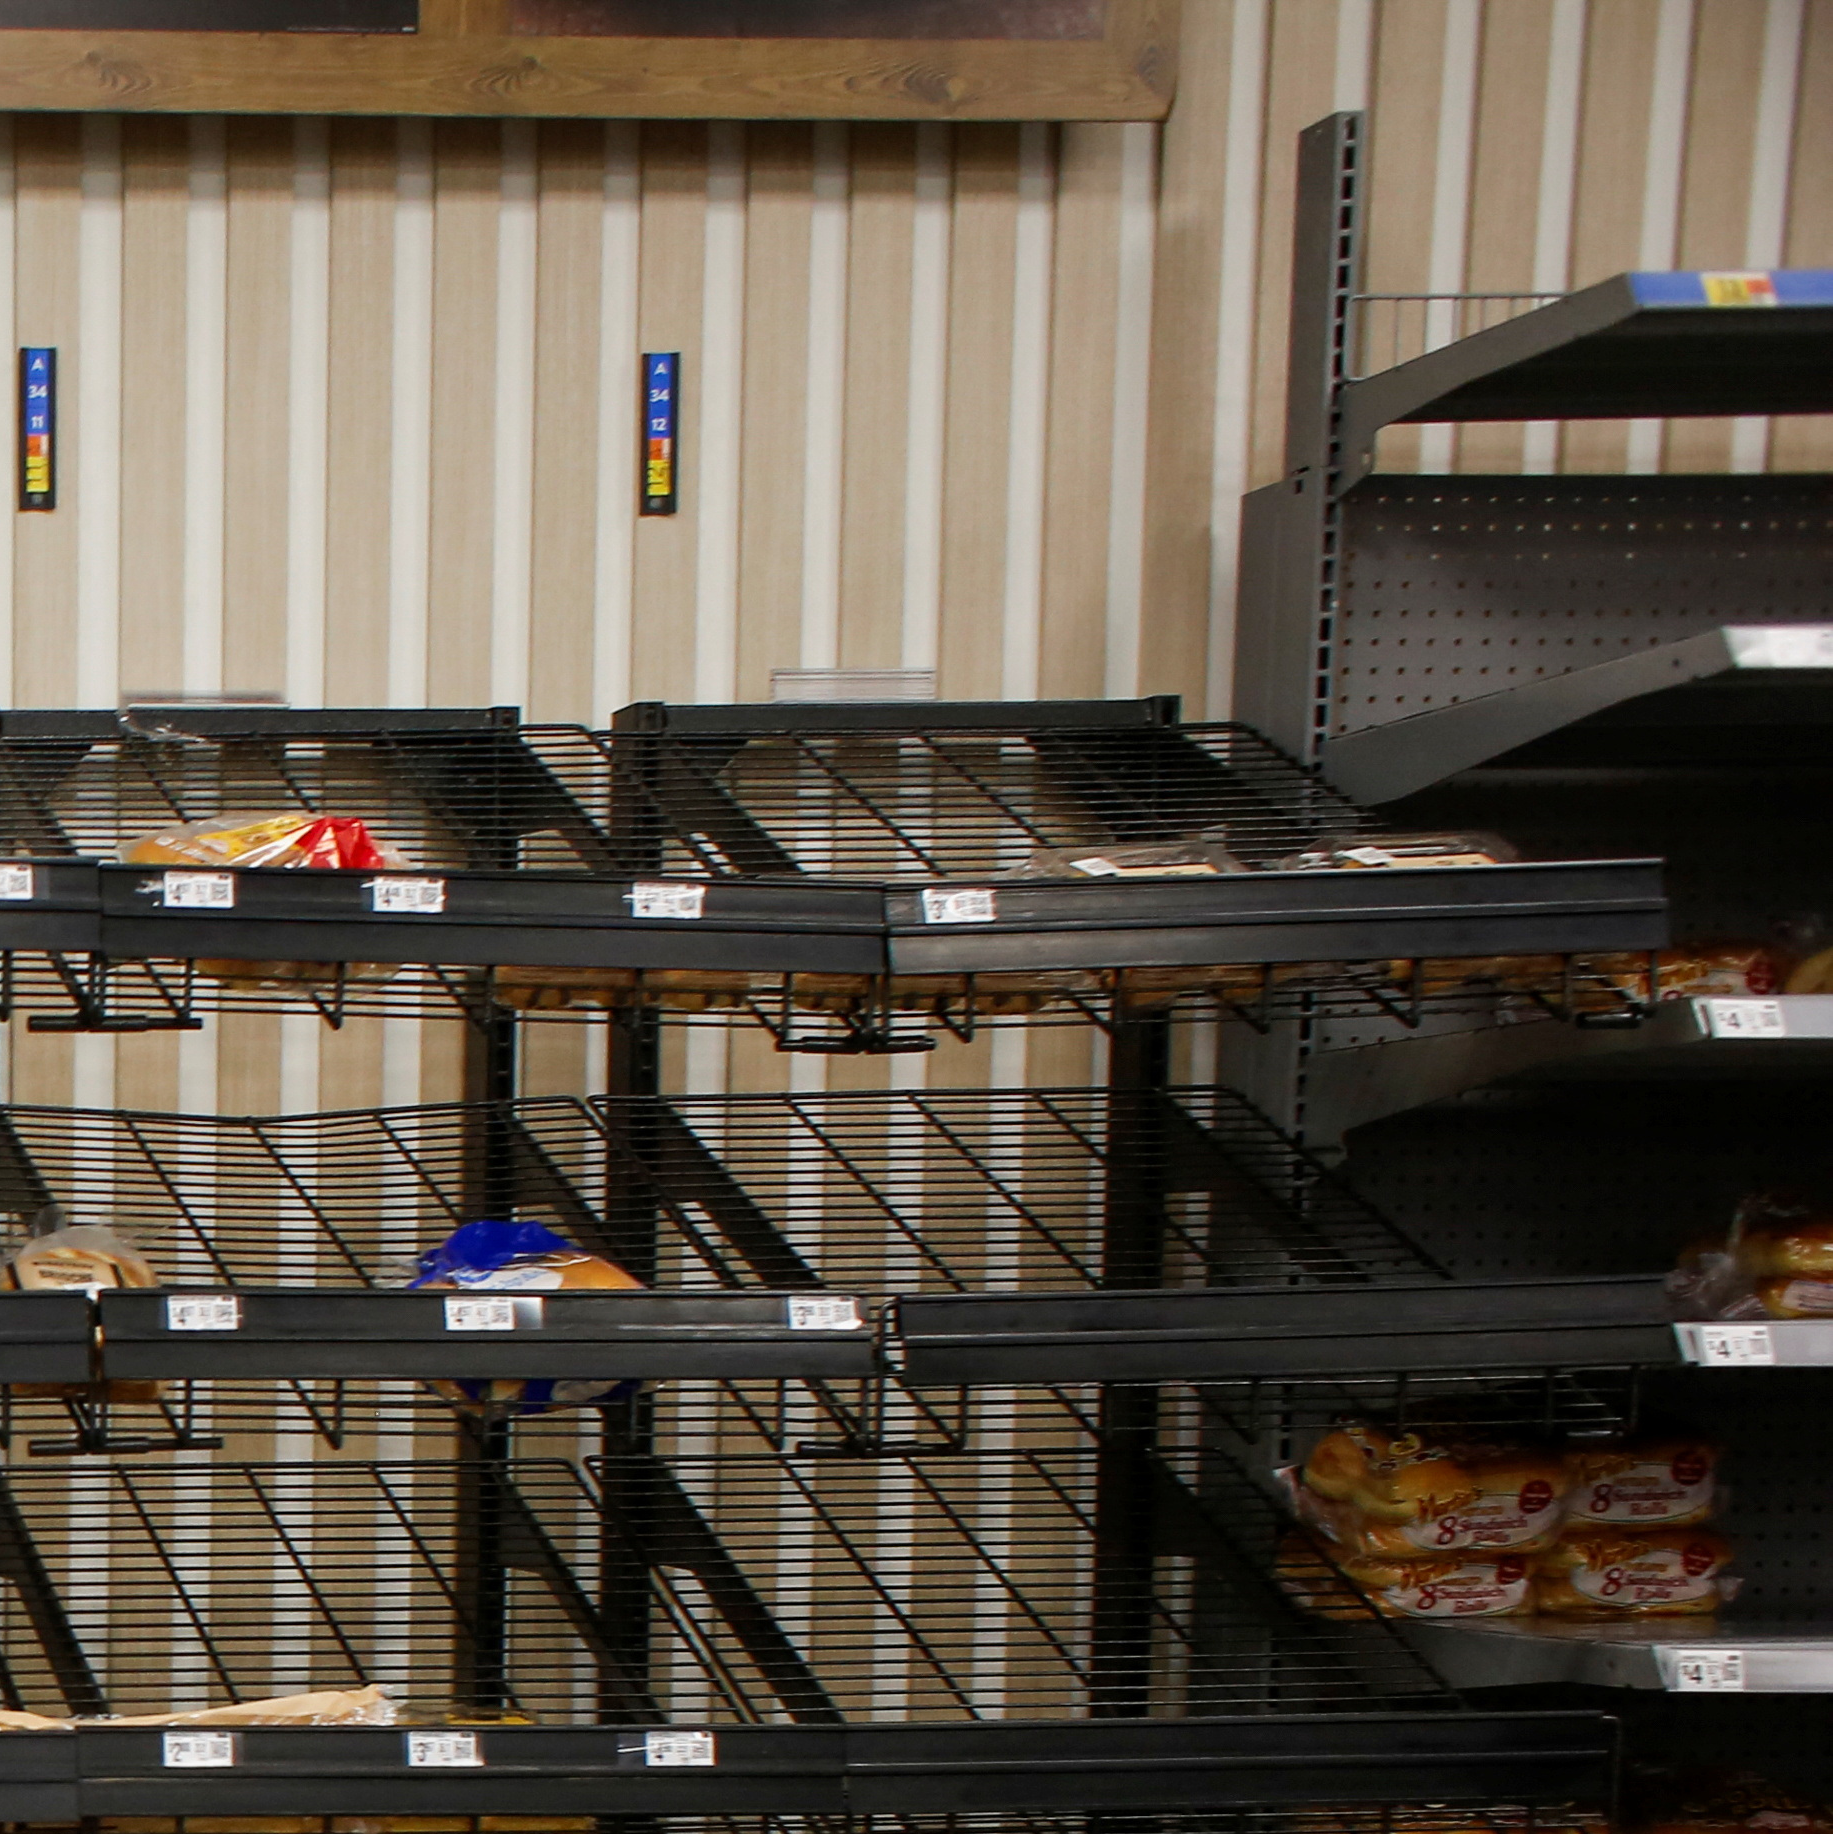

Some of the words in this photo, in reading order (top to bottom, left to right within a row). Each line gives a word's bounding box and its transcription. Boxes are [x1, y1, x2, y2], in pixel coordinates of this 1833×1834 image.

[32, 358, 44, 371] A
[653, 362, 667, 376] A
[28, 384, 47, 399] 34
[649, 388, 670, 403] 34
[31, 415, 44, 429] 11
[652, 418, 667, 431] 12
[1590, 1483, 1613, 1513] 8
[1437, 1516, 1457, 1545] 8
[1600, 1567, 1625, 1596] 8
